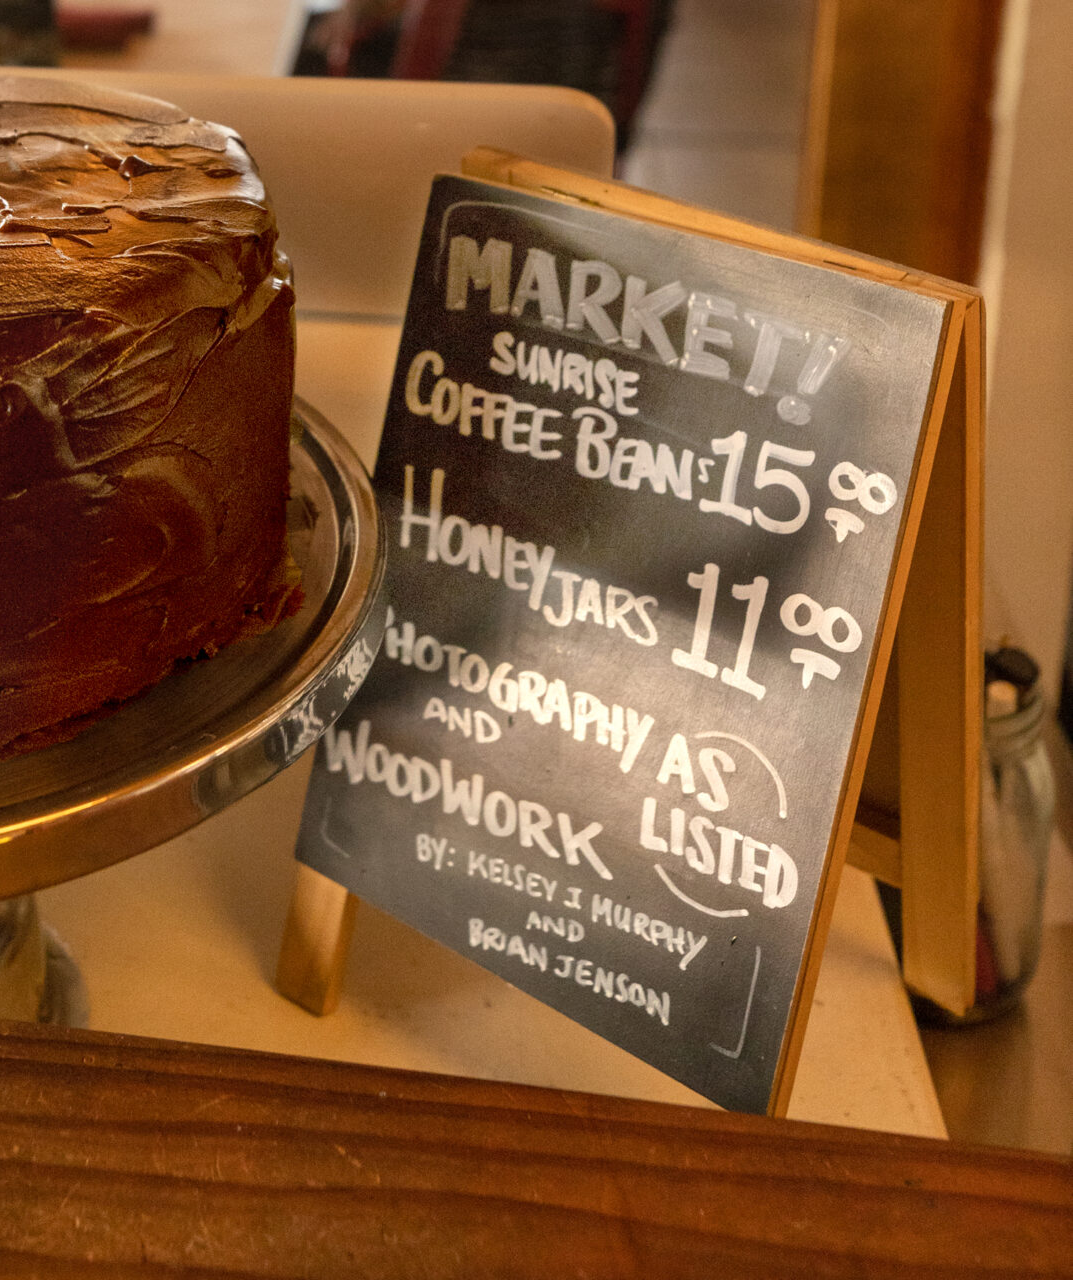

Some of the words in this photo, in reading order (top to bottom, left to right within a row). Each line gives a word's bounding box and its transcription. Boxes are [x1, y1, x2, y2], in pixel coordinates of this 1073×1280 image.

[446, 235, 852, 425] MARKET!
[490, 331, 640, 415] SUNRISE
[405, 351, 563, 460] COFFEE
[400, 465, 555, 610] HONEY
[543, 570, 659, 646] JARS
[424, 697, 502, 744] AND
[657, 733, 736, 812] AS
[326, 720, 613, 881] WOODWORK
[639, 797, 799, 909] LISTED
[416, 833, 457, 871] BY:
[467, 850, 558, 903] KELSEY
[591, 893, 709, 972] MURPHY
[525, 910, 586, 943] AND
[553, 954, 671, 1027] JENSON
